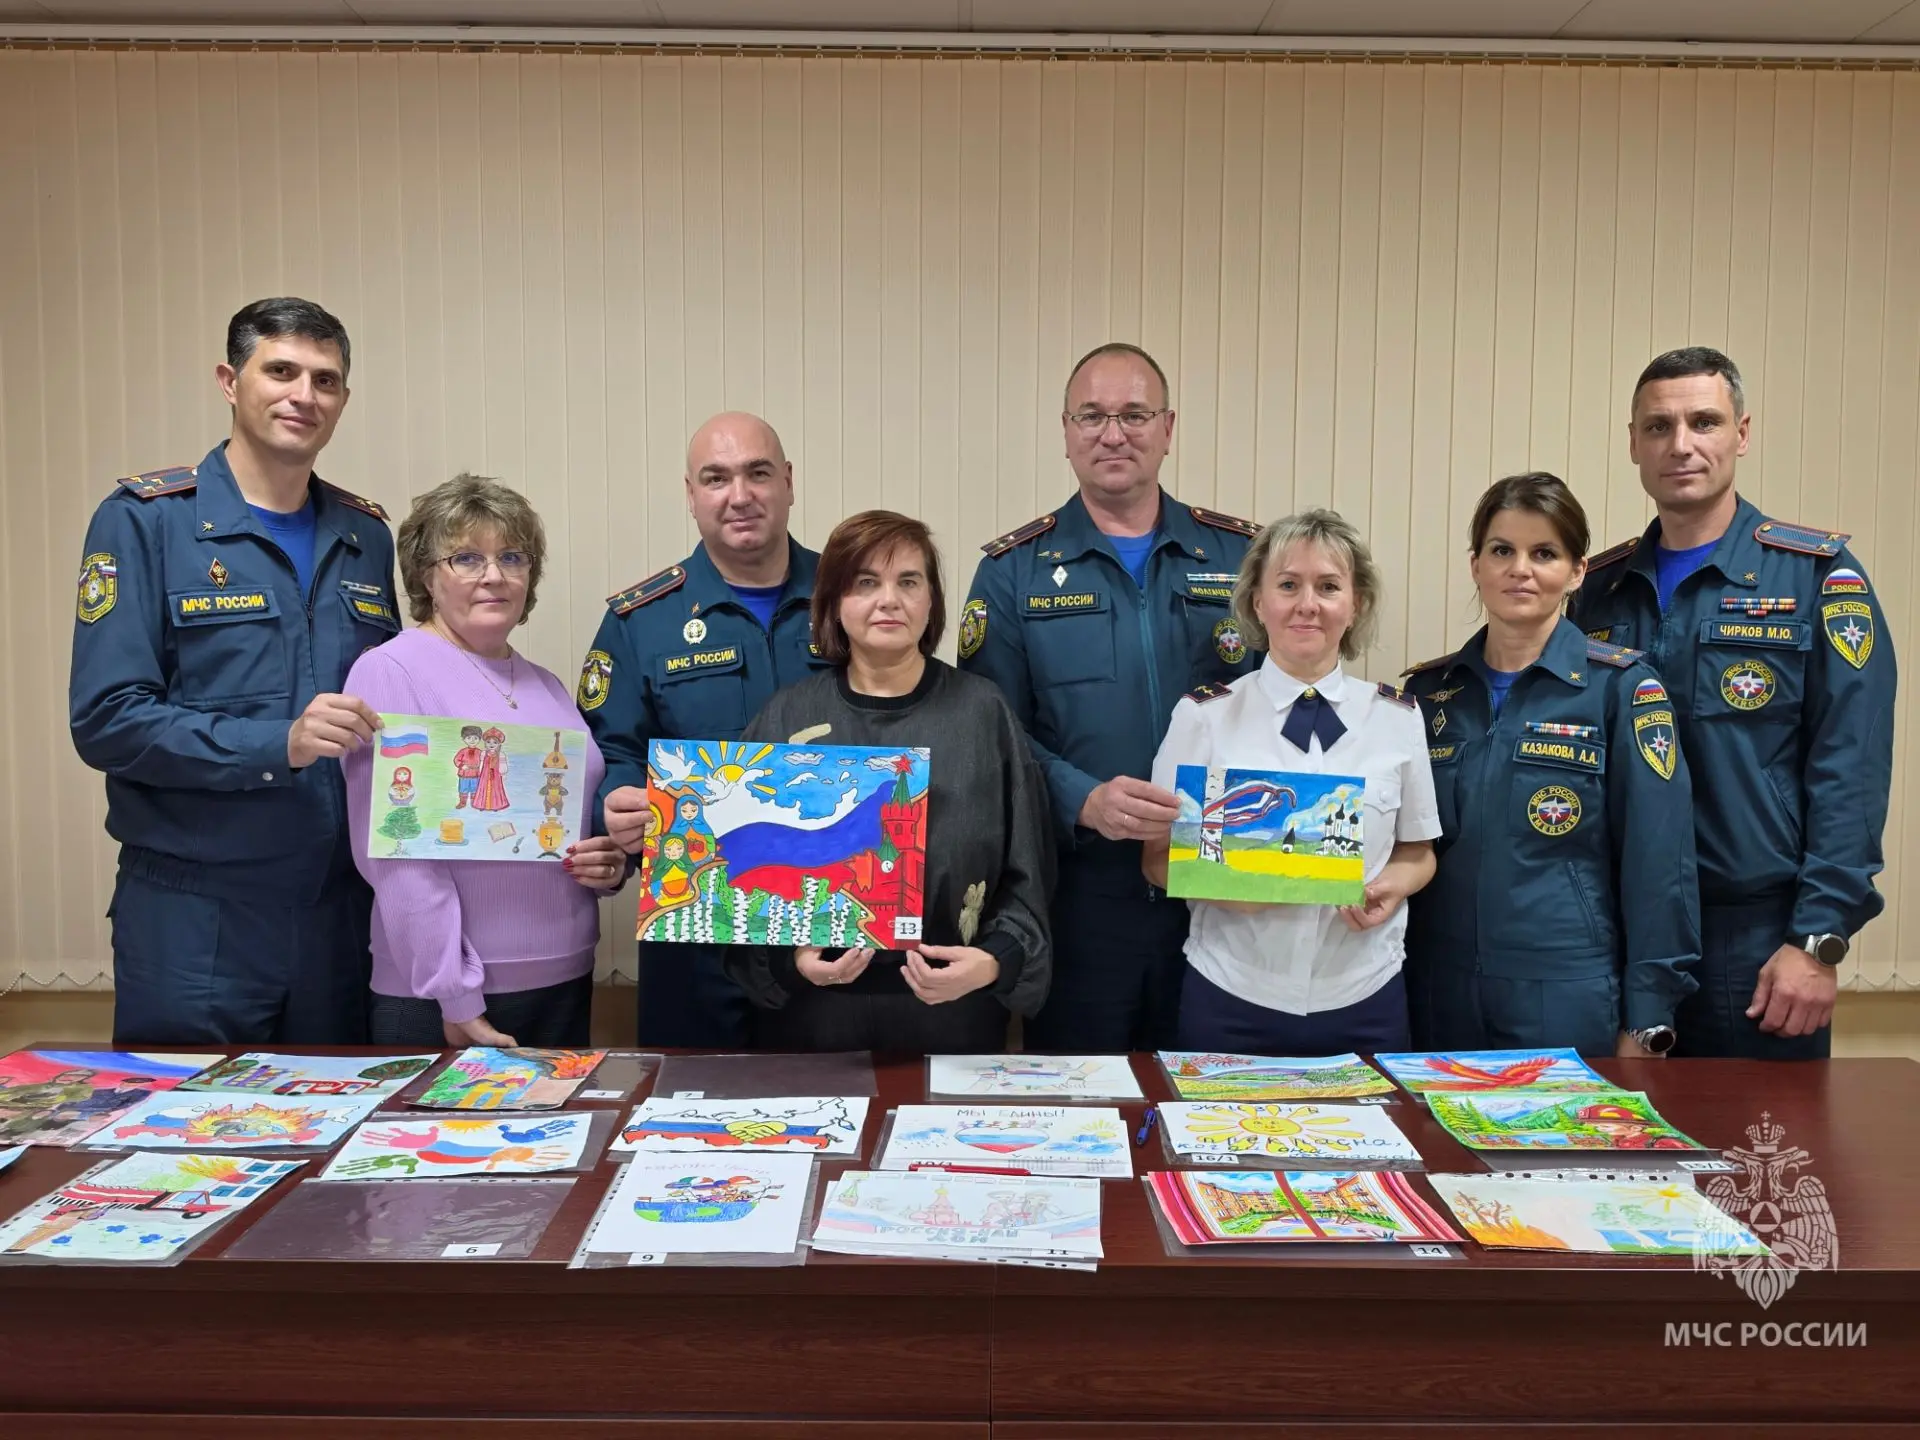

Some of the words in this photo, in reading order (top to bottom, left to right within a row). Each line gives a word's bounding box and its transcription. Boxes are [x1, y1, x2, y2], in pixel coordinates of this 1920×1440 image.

[182, 597, 212, 612] МЧС
[215, 594, 265, 609] РОССИИ
[1030, 597, 1051, 608] МЧС
[1054, 594, 1094, 607] РОССИИ
[1825, 605, 1842, 617] МЧС
[1842, 603, 1870, 615] РОССИИ
[1719, 624, 1763, 638] ЧИРКОВ
[1766, 627, 1793, 640] М.Ю.
[667, 657, 691, 670] МЧС
[693, 649, 735, 664] РОССИИ
[1725, 663, 1743, 680] МЧС
[1744, 661, 1773, 685] РОССИИ
[1639, 692, 1664, 702] РОССИЯ
[1724, 687, 1770, 708] EMERCOM
[1636, 714, 1651, 728] МЧС
[1429, 746, 1455, 759] ОССИИ
[1521, 741, 1575, 760] КАЗАКОВА
[1578, 749, 1599, 765] А.А.
[1531, 790, 1547, 807] МЧС
[1549, 787, 1579, 809] РОССИИ
[1530, 812, 1578, 833] EMERCOM
[899, 922, 917, 935] 13
[465, 1246, 479, 1254] 6
[641, 1254, 654, 1262] 9
